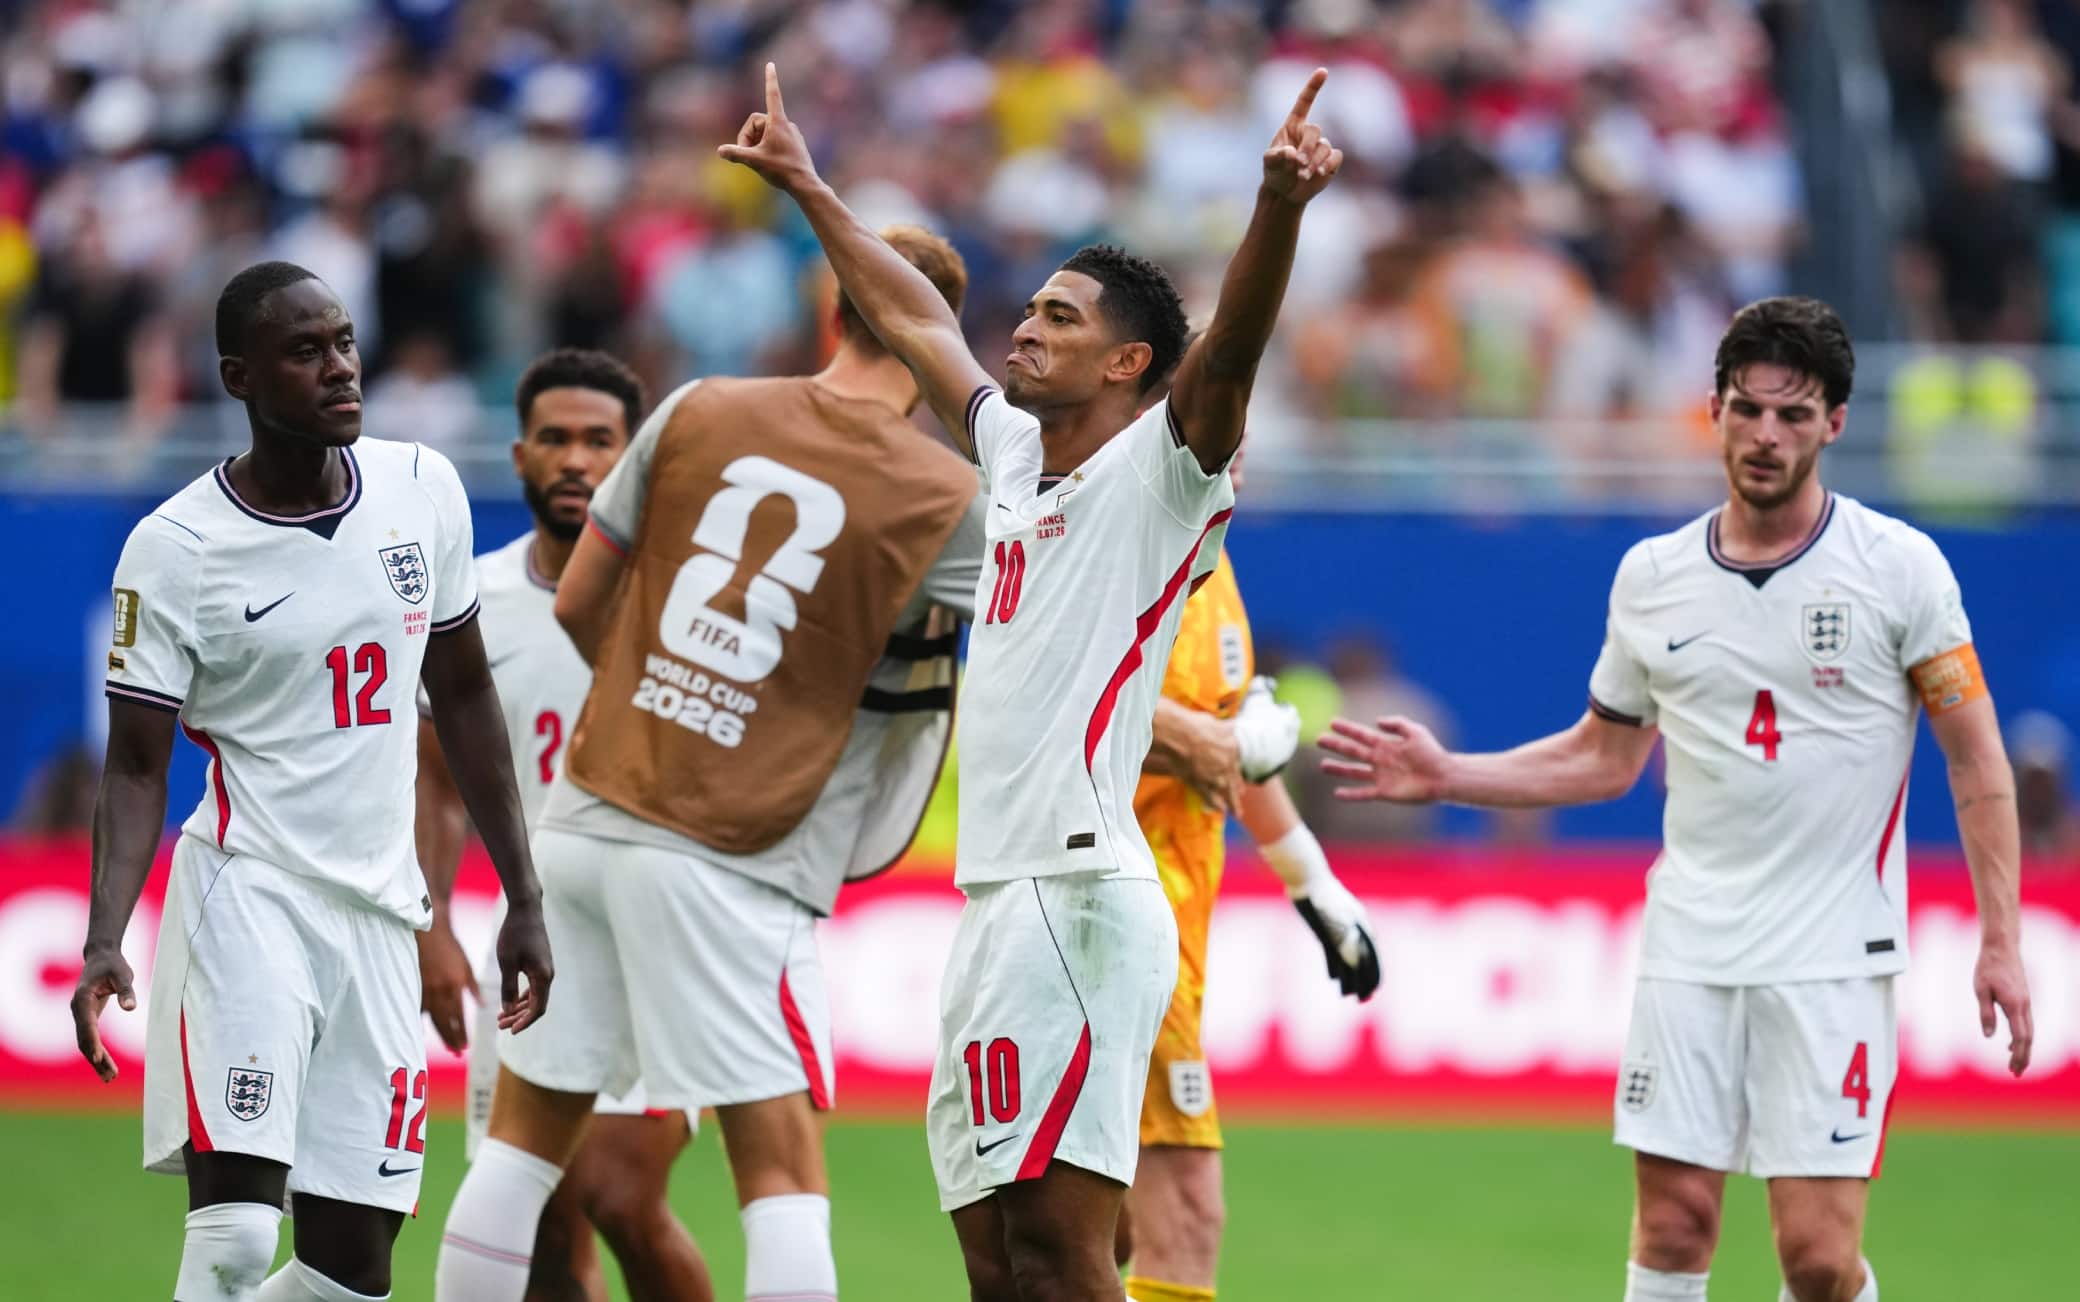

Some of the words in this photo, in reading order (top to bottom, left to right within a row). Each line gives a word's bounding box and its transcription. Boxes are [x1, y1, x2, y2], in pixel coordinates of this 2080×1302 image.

[1034, 513, 1066, 527] RANCE
[985, 539, 1026, 625] 10
[686, 617, 742, 657] FIFA
[325, 641, 392, 729] 12
[630, 676, 747, 749] 2026
[645, 653, 711, 695] WORLD
[709, 682, 758, 715] CUP
[535, 709, 563, 785] 2
[1745, 688, 1783, 763] 4
[384, 1066, 427, 1155] 12
[963, 1036, 1022, 1128] 10
[1842, 1041, 1872, 1119] 4
